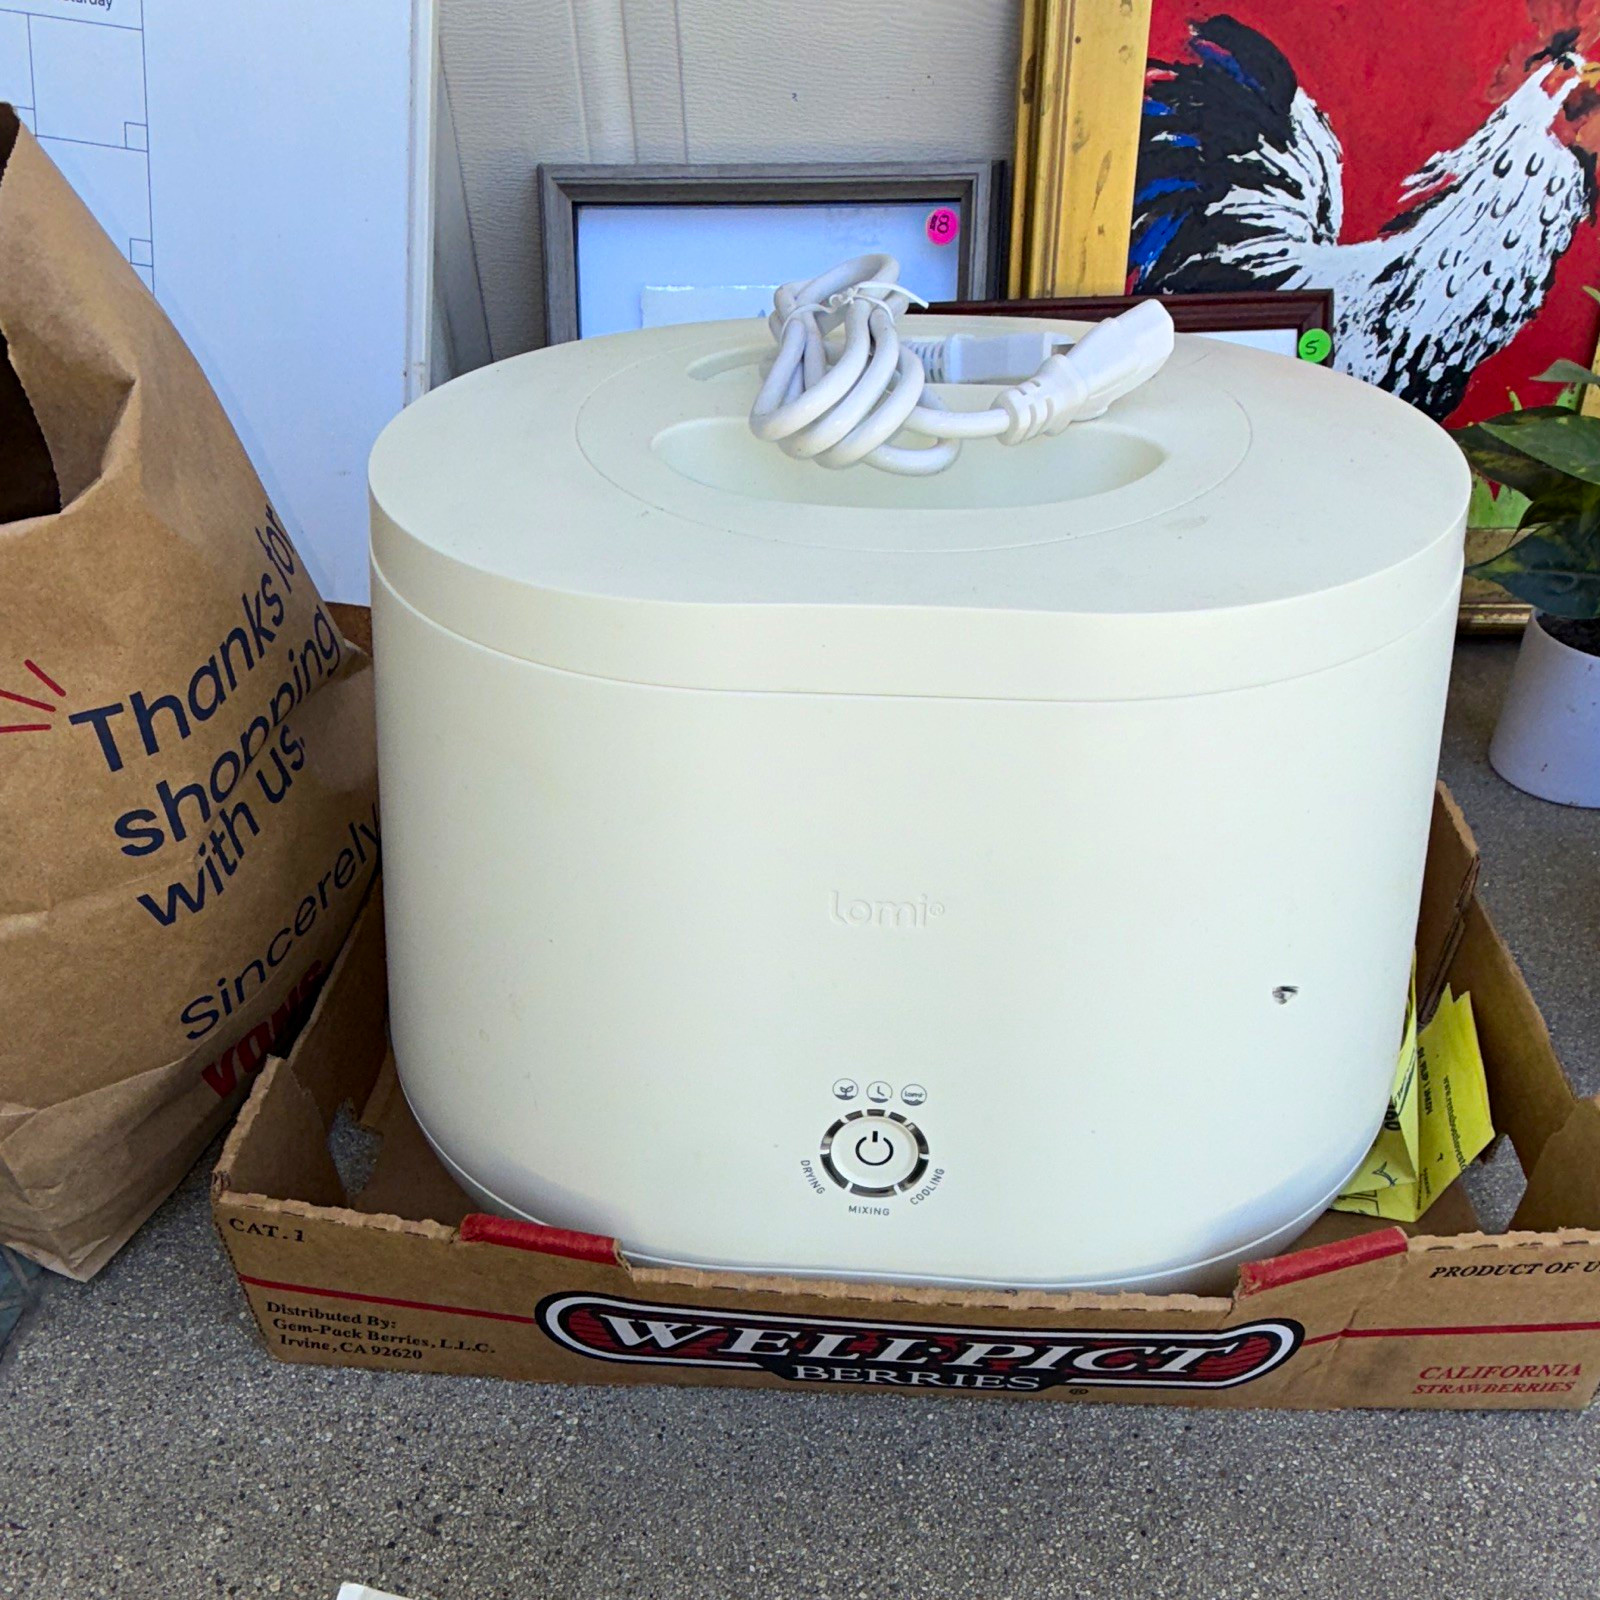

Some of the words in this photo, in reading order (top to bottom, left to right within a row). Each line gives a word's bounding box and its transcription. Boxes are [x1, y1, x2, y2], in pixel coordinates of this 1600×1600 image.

[69, 573, 284, 772] Thanks
[255, 504, 295, 594] for
[114, 605, 341, 856] shopping
[137, 802, 260, 926] with
[800, 1159, 826, 1195] DRYING
[910, 1168, 945, 1205] COOLING
[849, 1205, 890, 1216] MIXING
[1429, 1262, 1543, 1279] PRODUCT
[1545, 1261, 1580, 1274] OF
[266, 1301, 363, 1324] Distributed
[367, 1315, 397, 1329] By:
[273, 1318, 363, 1339] Gem-Pack
[371, 1345, 423, 1359] 92620
[793, 1364, 1040, 1390] BERRIES
[1419, 1363, 1582, 1380] CALIFORNIA
[1412, 1381, 1576, 1395] STRAWBERRIES
